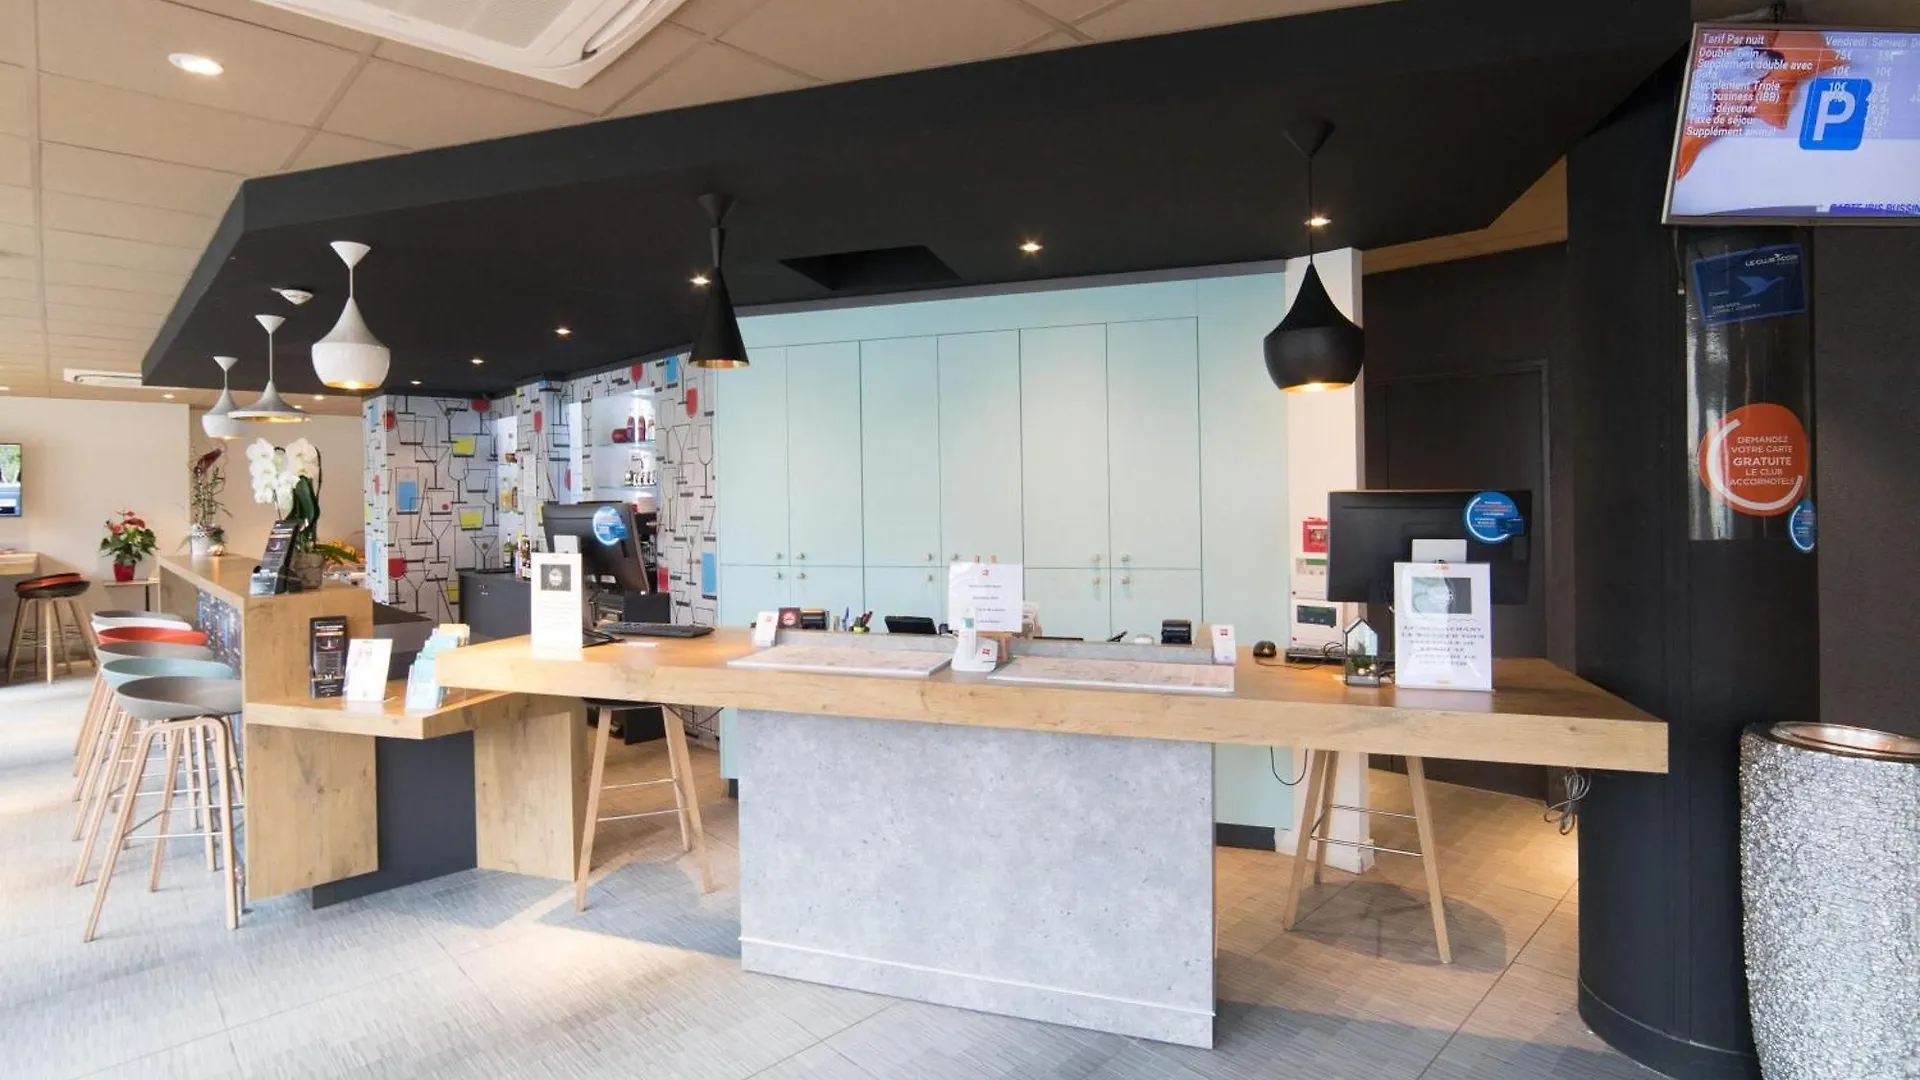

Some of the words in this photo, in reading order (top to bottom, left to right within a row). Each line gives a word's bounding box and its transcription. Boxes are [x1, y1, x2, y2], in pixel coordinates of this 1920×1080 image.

[1702, 33, 1726, 45] Tarif
[1727, 34, 1744, 45] Par
[1745, 34, 1765, 45] nuit
[1825, 36, 1868, 46] Vendredi
[1872, 37, 1907, 47] Samedi
[1790, 61, 1813, 71] avec
[1754, 80, 1781, 92] Triple
[1712, 90, 1755, 101] business
[1713, 115, 1726, 125] de
[1686, 126, 1743, 138] Supplément
[1737, 435, 1789, 444] DEMANDEZ
[1731, 445, 1765, 454] VOTRE
[1766, 445, 1793, 453] CARTE
[1732, 456, 1792, 467] GRATUITE
[1745, 468, 1758, 476] LE
[1759, 468, 1783, 477] CLUB
